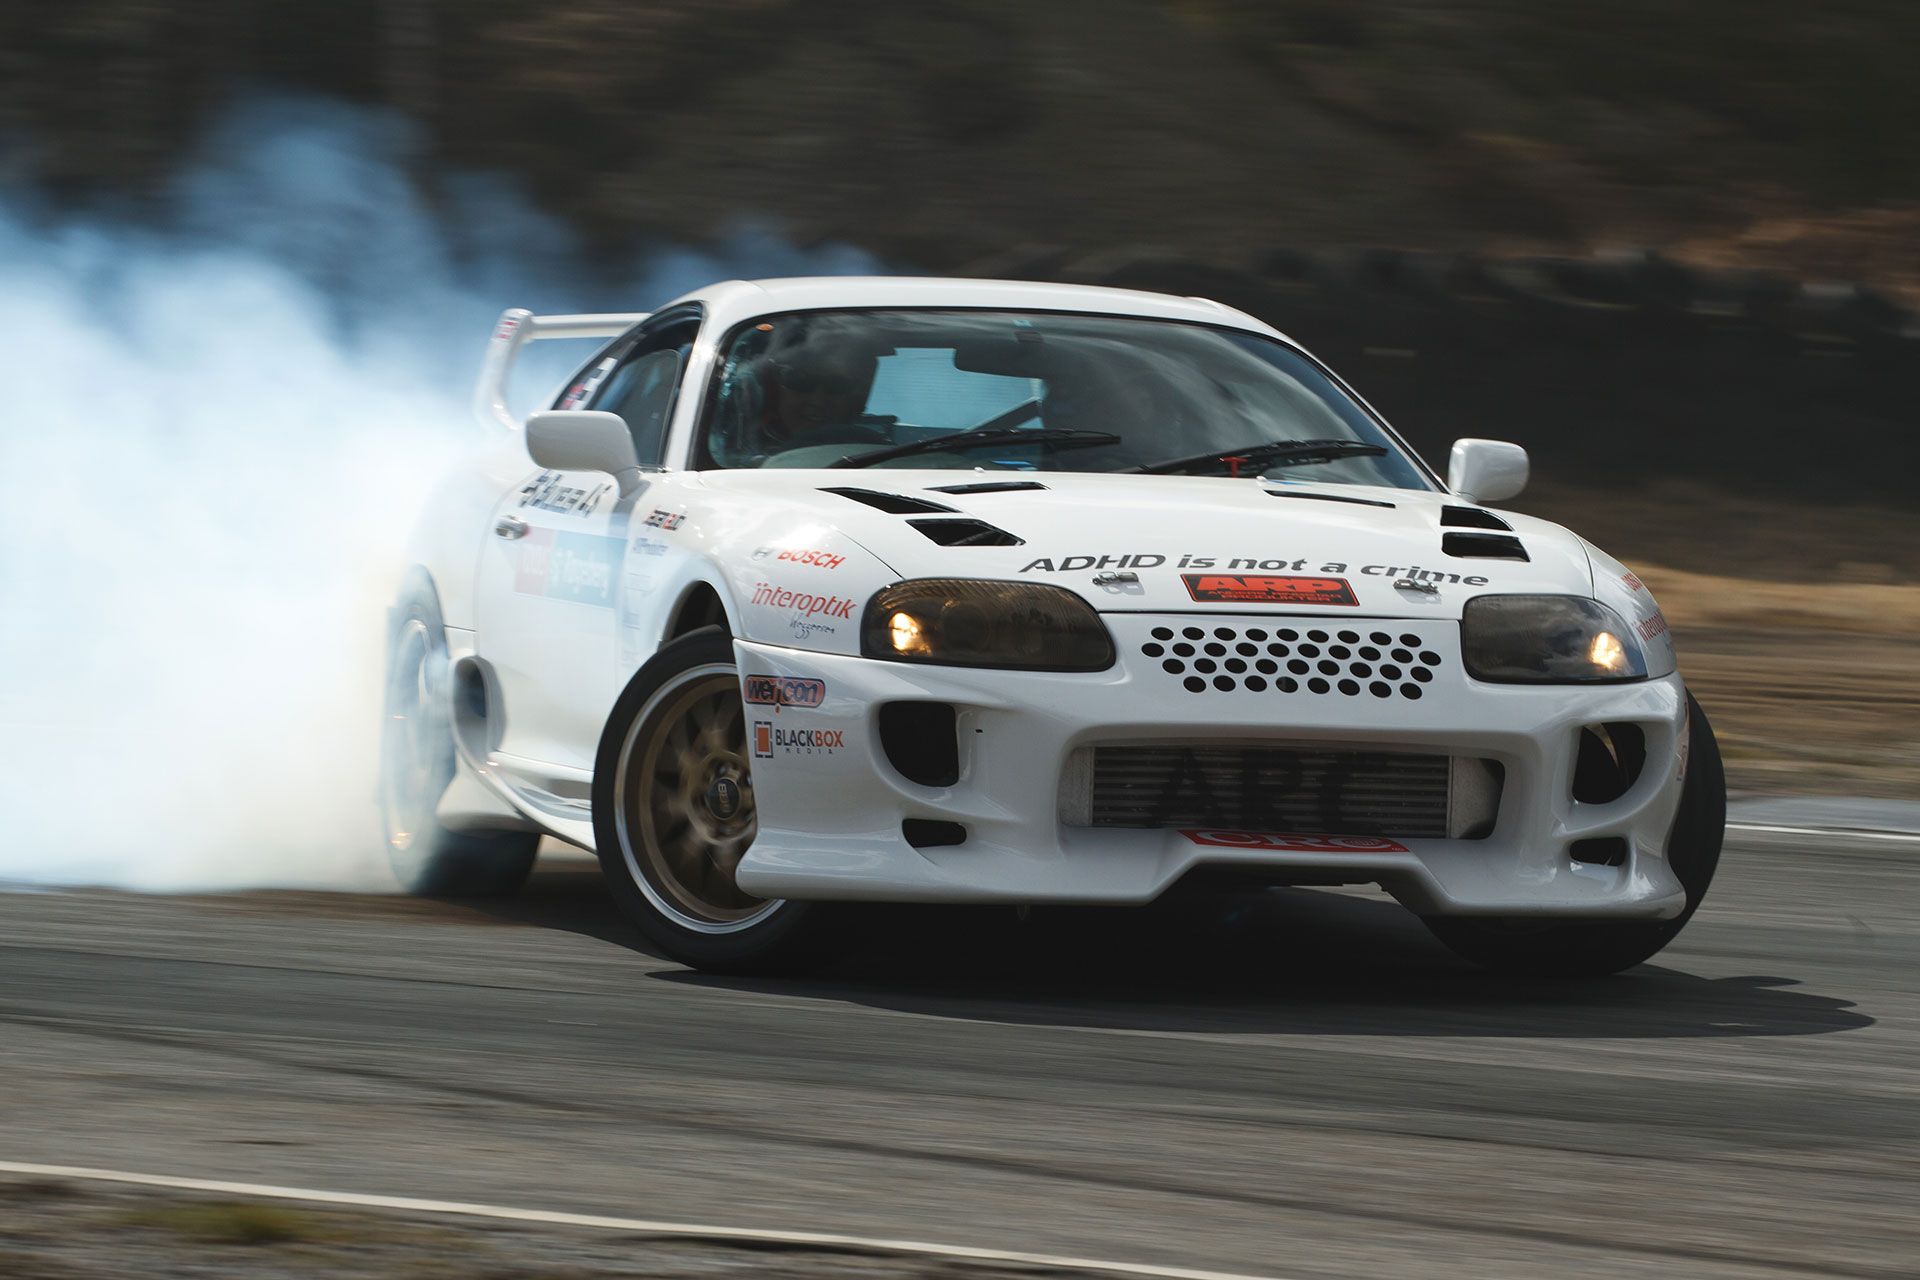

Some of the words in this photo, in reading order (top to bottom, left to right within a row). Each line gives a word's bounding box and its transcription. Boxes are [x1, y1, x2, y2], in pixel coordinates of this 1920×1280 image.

[777, 550, 846, 570] BOSCH
[1018, 554, 1166, 573] ADHD
[1176, 554, 1217, 569] is
[1228, 558, 1307, 572] not
[1319, 562, 1348, 574] a
[1360, 565, 1489, 587] crime
[1196, 576, 1342, 593] ARP
[775, 729, 844, 748] BLACKBOX
[785, 747, 834, 755] MEDIA
